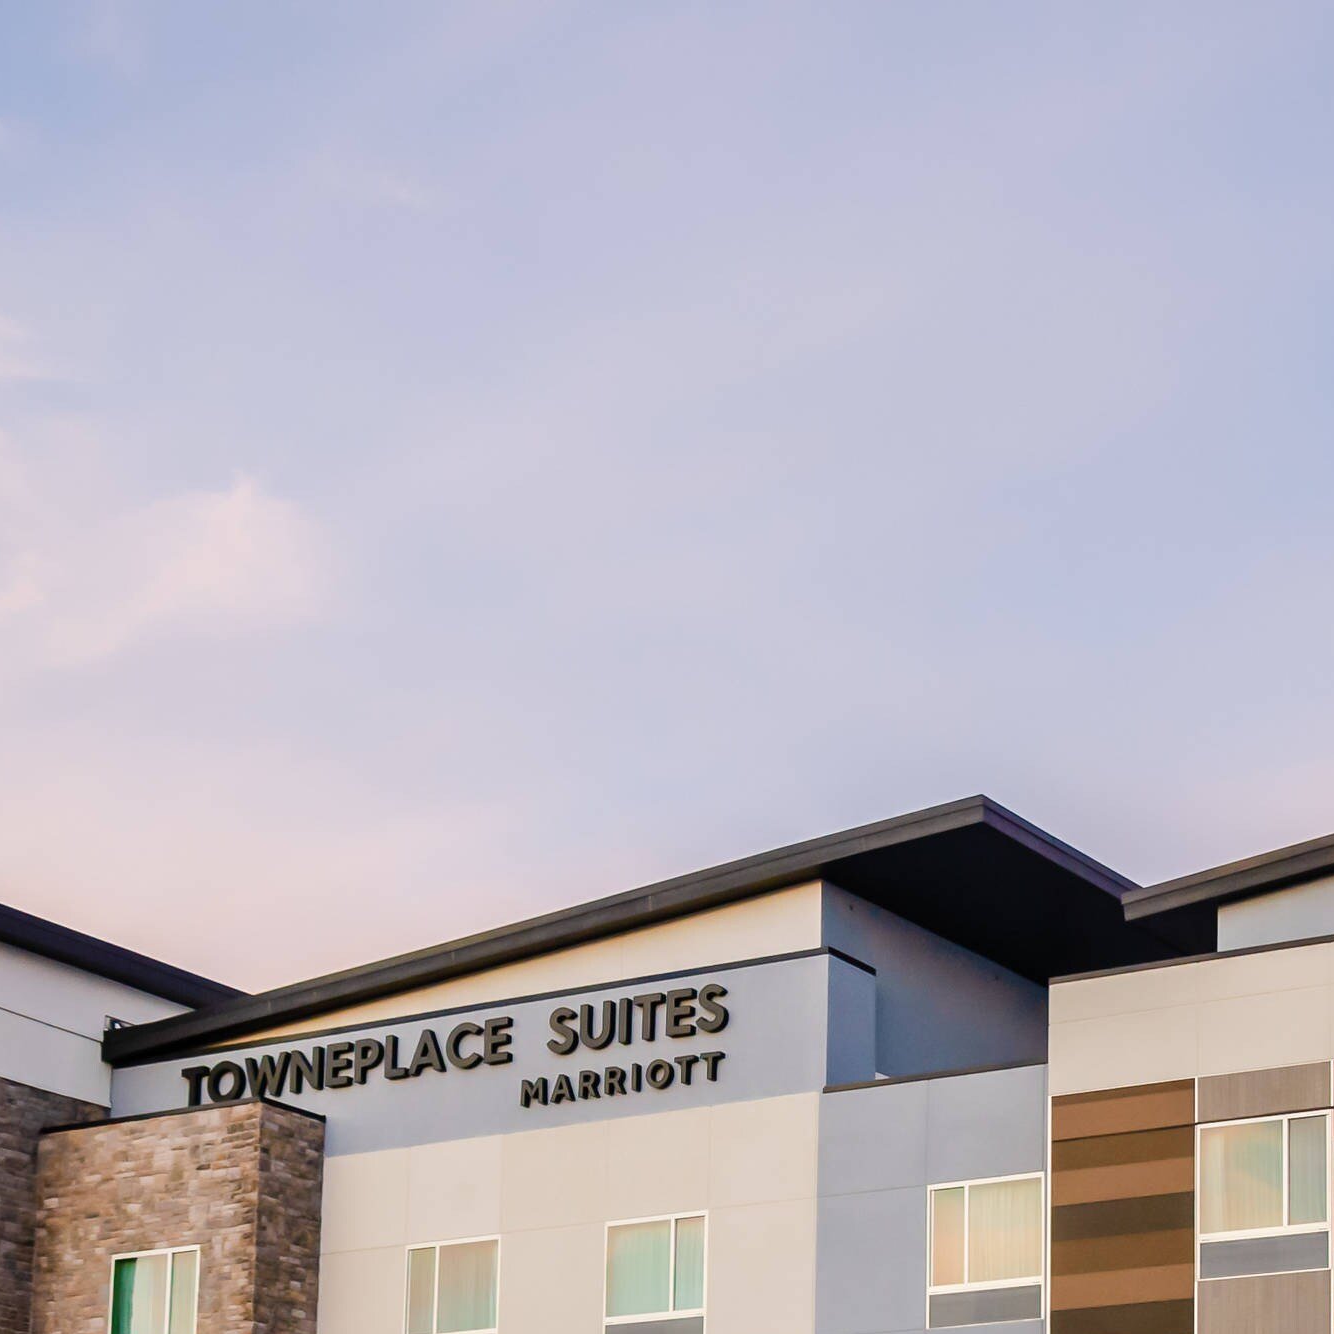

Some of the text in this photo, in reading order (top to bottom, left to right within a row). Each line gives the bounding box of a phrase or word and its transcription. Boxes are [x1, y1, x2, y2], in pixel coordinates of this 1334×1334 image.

[181, 983, 730, 1107] TOWNEPLACE SUITES
[520, 1051, 726, 1109] MARRIOTT
